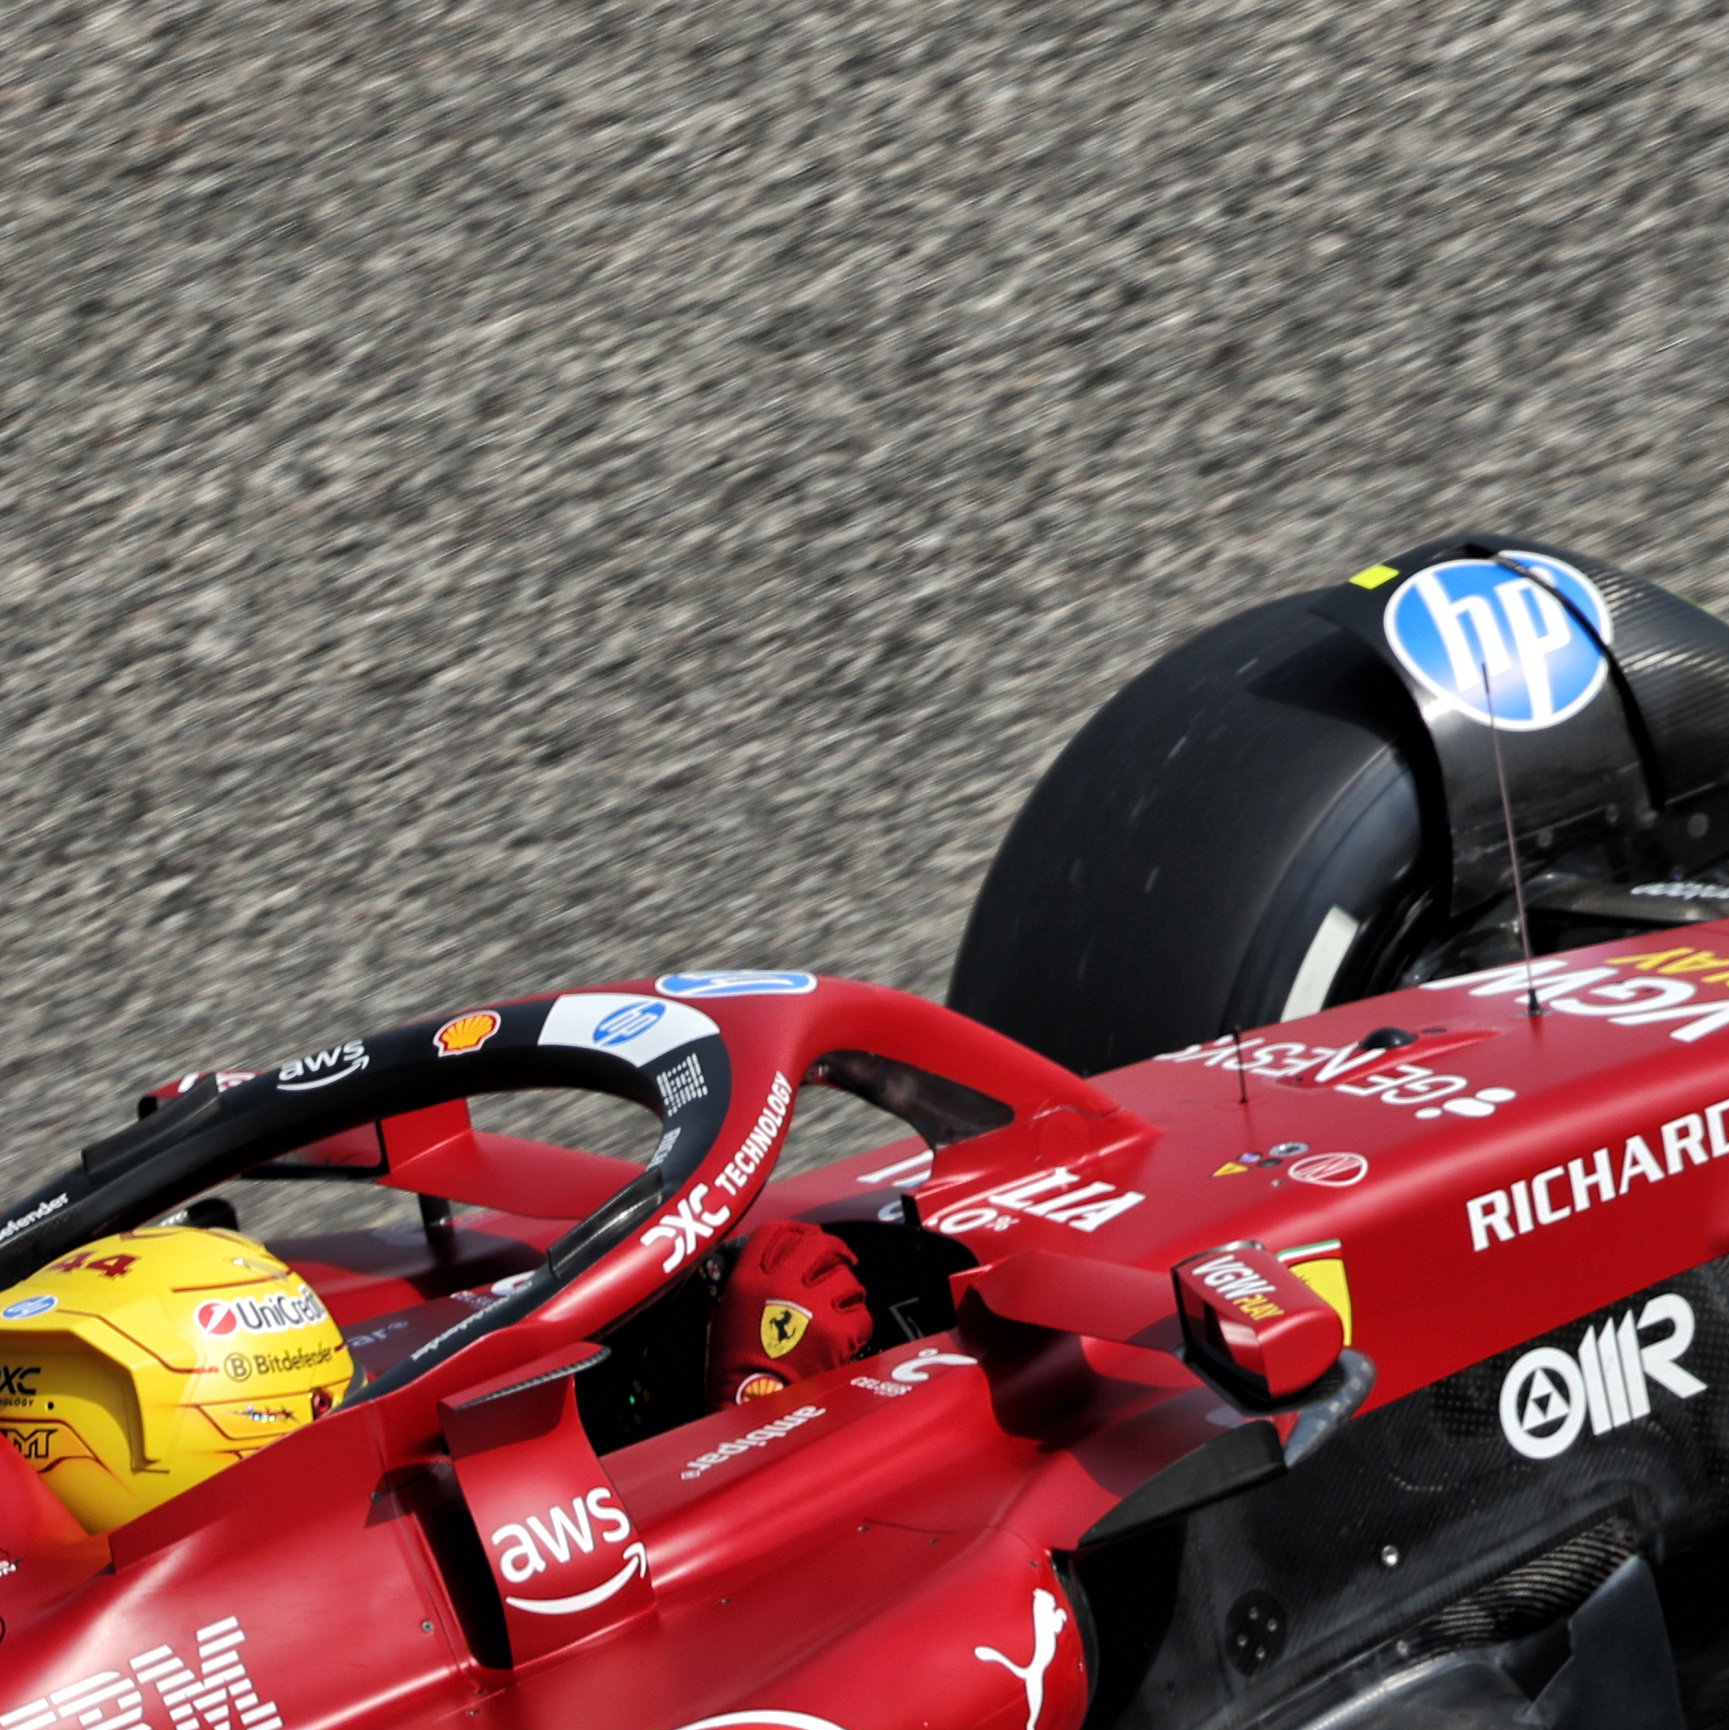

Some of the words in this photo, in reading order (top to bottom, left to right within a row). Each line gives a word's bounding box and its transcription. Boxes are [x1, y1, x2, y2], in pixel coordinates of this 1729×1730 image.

[1410, 556, 1572, 723] hp
[278, 1040, 366, 1083] aws
[640, 1181, 731, 1274] DXC
[713, 1069, 795, 1198] TECHNOLOGY
[47, 1251, 142, 1281] 44
[1191, 1254, 1277, 1301] VGW
[253, 1343, 332, 1375] Bitdefender
[686, 1404, 827, 1473] ambipar
[490, 1486, 632, 1585] aws
